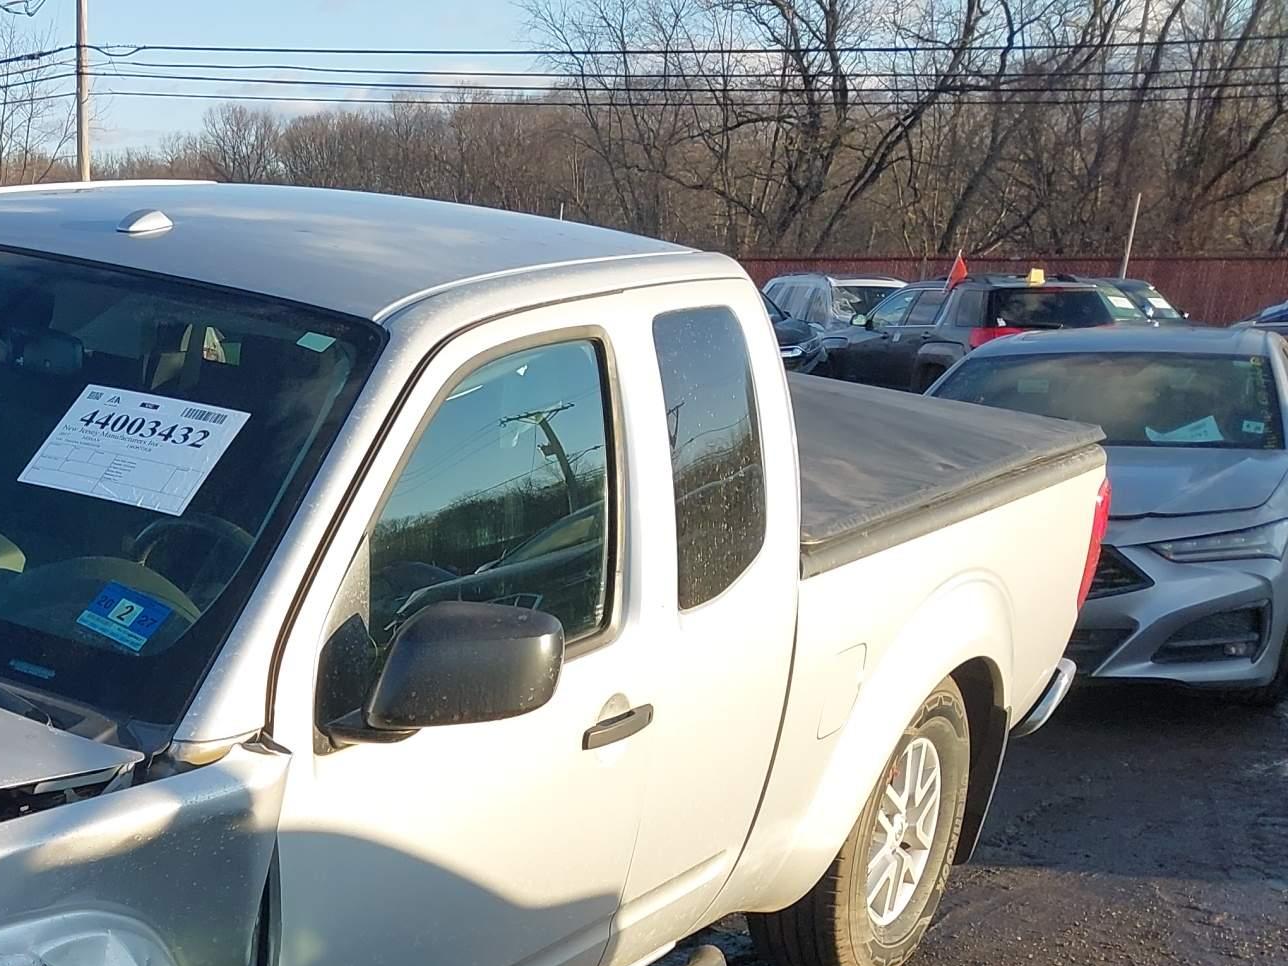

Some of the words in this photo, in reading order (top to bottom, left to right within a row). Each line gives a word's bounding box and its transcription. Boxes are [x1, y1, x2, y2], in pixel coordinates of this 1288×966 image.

[63, 424, 78, 432] New
[78, 426, 100, 437] Jersey
[80, 410, 210, 449] 44003432
[117, 604, 134, 622] 2
